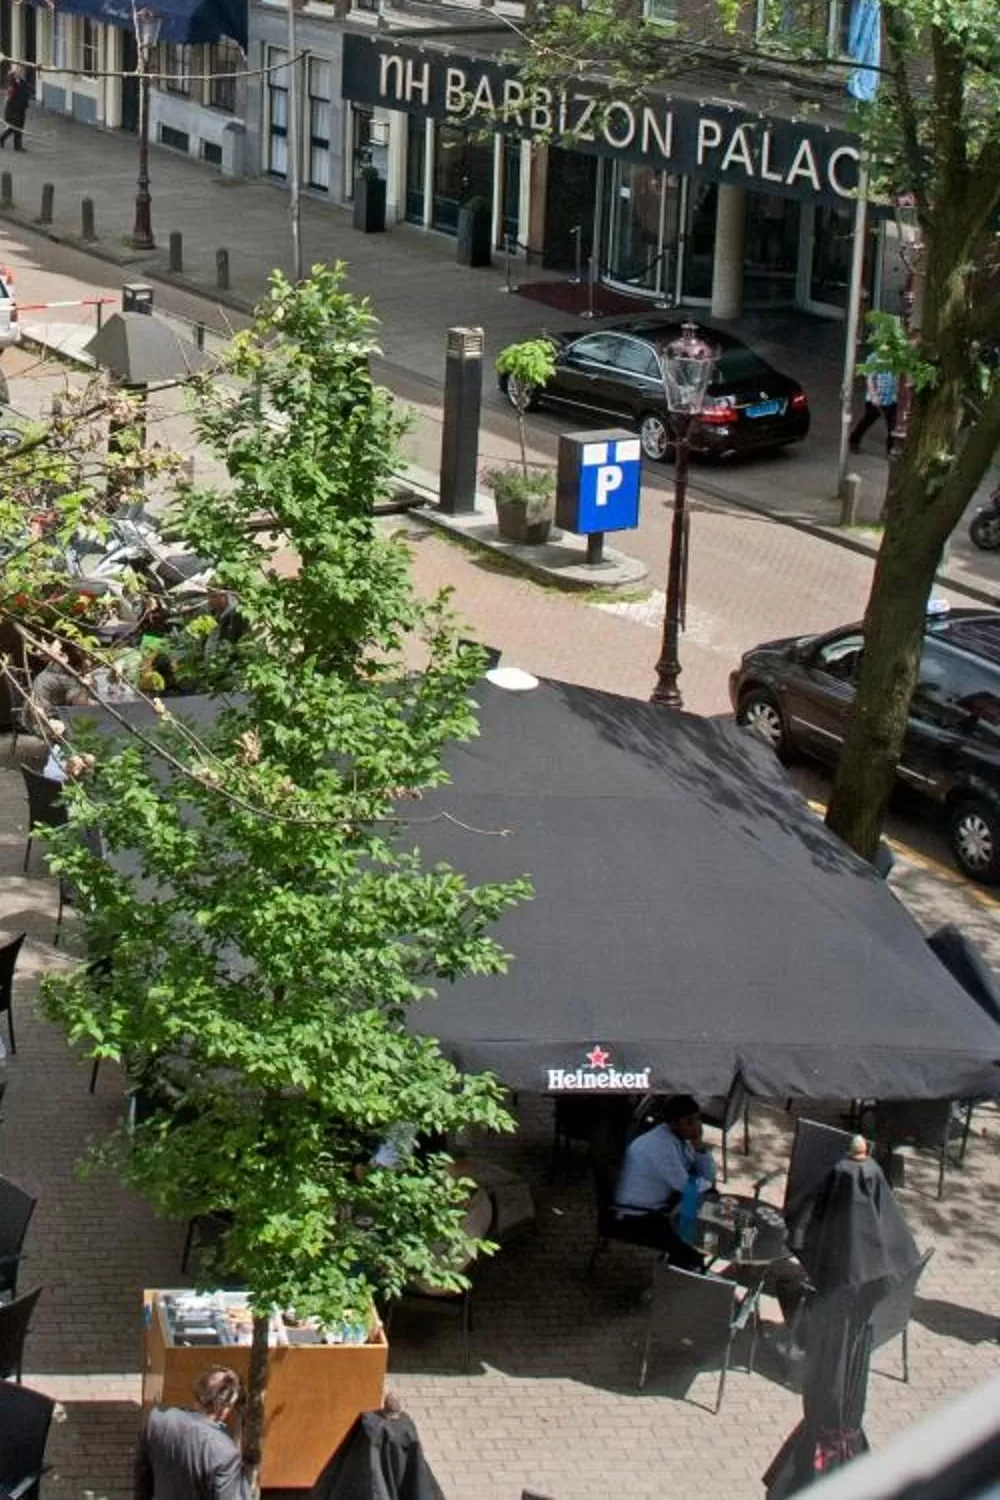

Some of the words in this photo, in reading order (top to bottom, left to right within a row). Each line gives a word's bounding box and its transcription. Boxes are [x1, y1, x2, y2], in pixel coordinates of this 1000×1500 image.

[445, 67, 673, 159] BARBIZON
[697, 119, 866, 200] PALAC
[595, 465, 623, 506] P
[547, 1068, 649, 1090] Heineken
